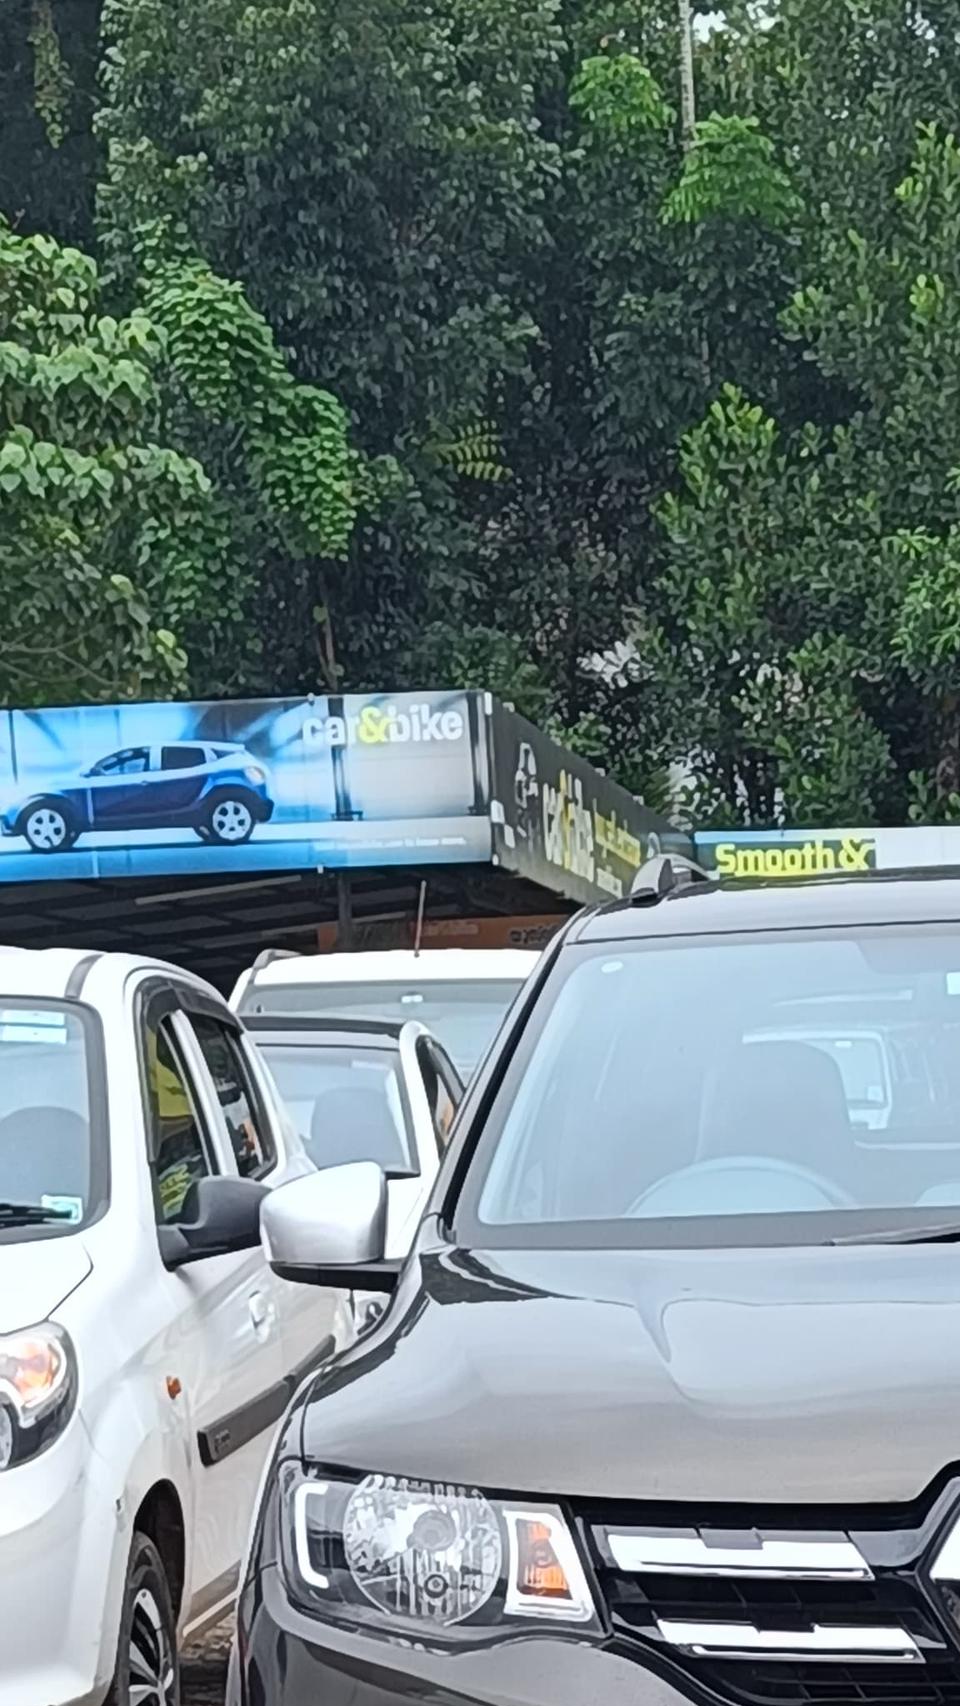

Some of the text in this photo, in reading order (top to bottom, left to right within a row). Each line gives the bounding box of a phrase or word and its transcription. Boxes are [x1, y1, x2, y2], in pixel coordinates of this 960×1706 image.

[304, 705, 463, 745] car&bike
[715, 838, 875, 876] Smooth &
